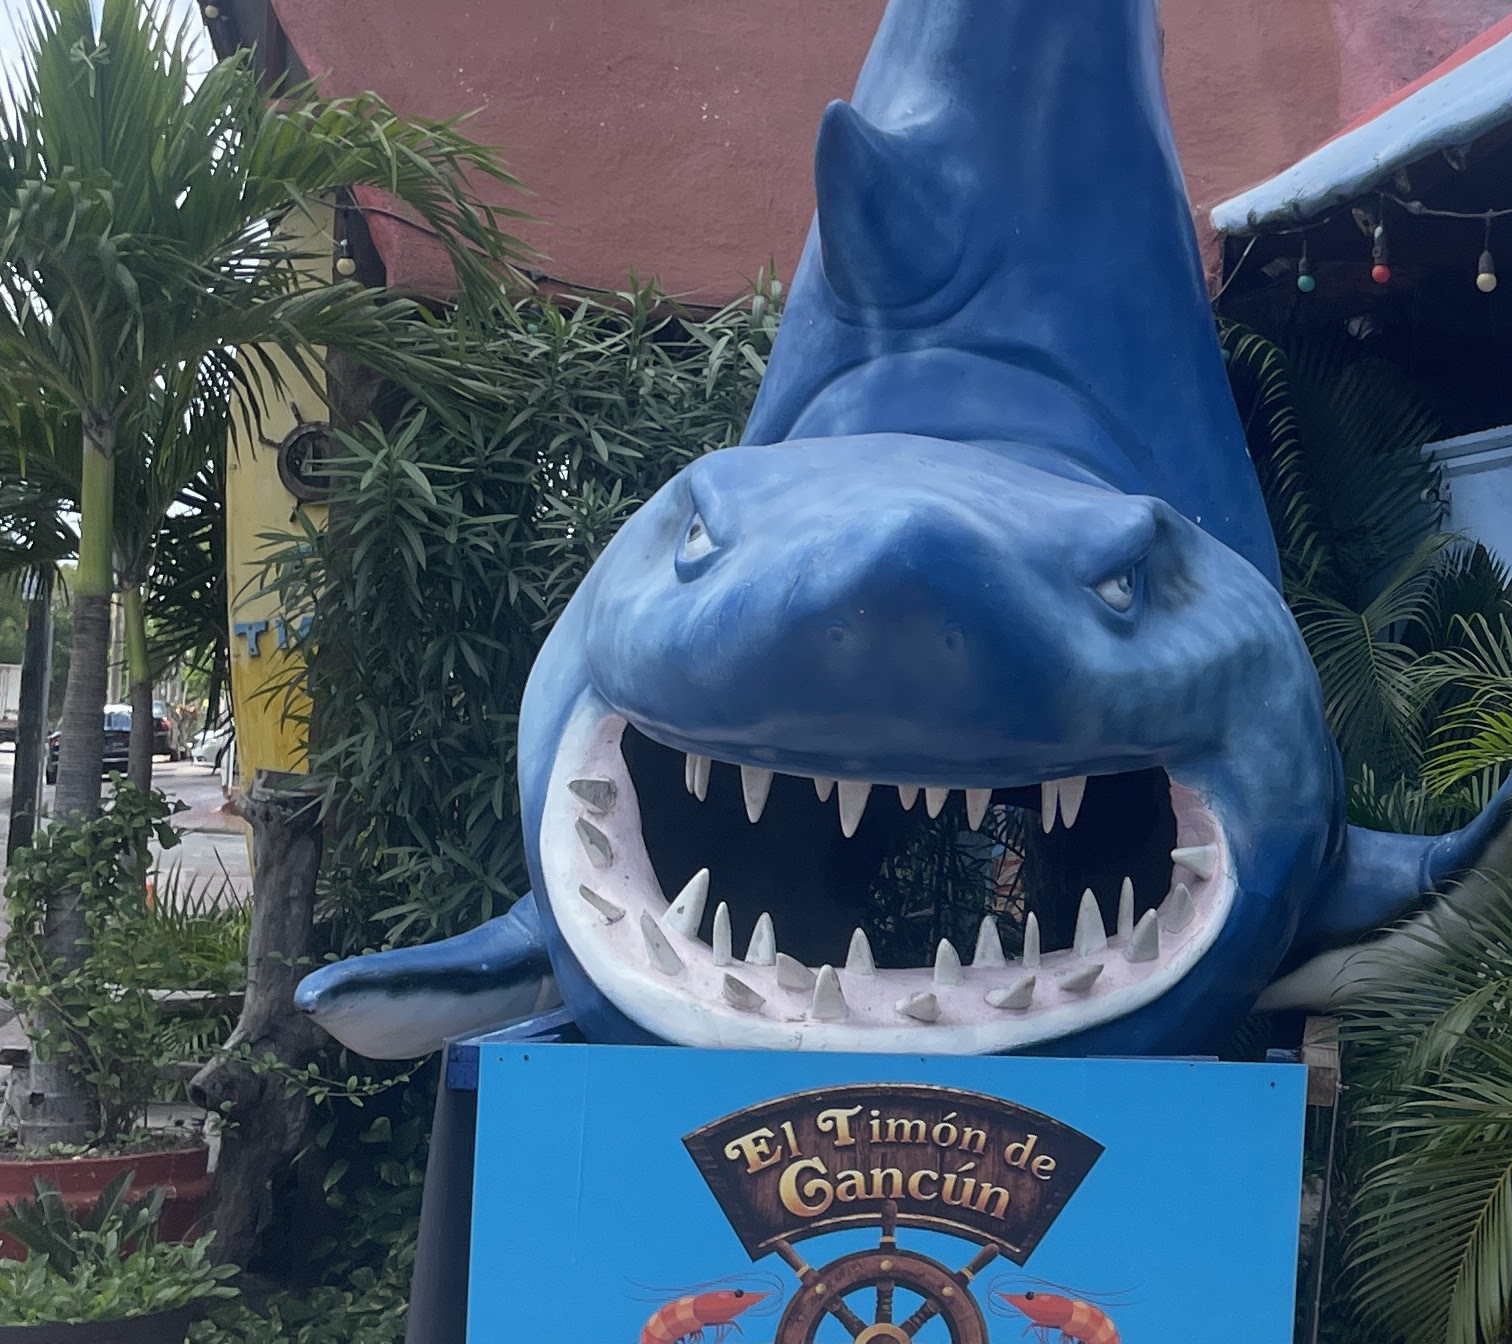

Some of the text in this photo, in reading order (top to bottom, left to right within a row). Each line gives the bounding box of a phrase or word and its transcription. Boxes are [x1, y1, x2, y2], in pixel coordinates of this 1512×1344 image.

[724, 1105, 1057, 1180] El Timón de
[779, 1156, 1010, 1219] Cancún
